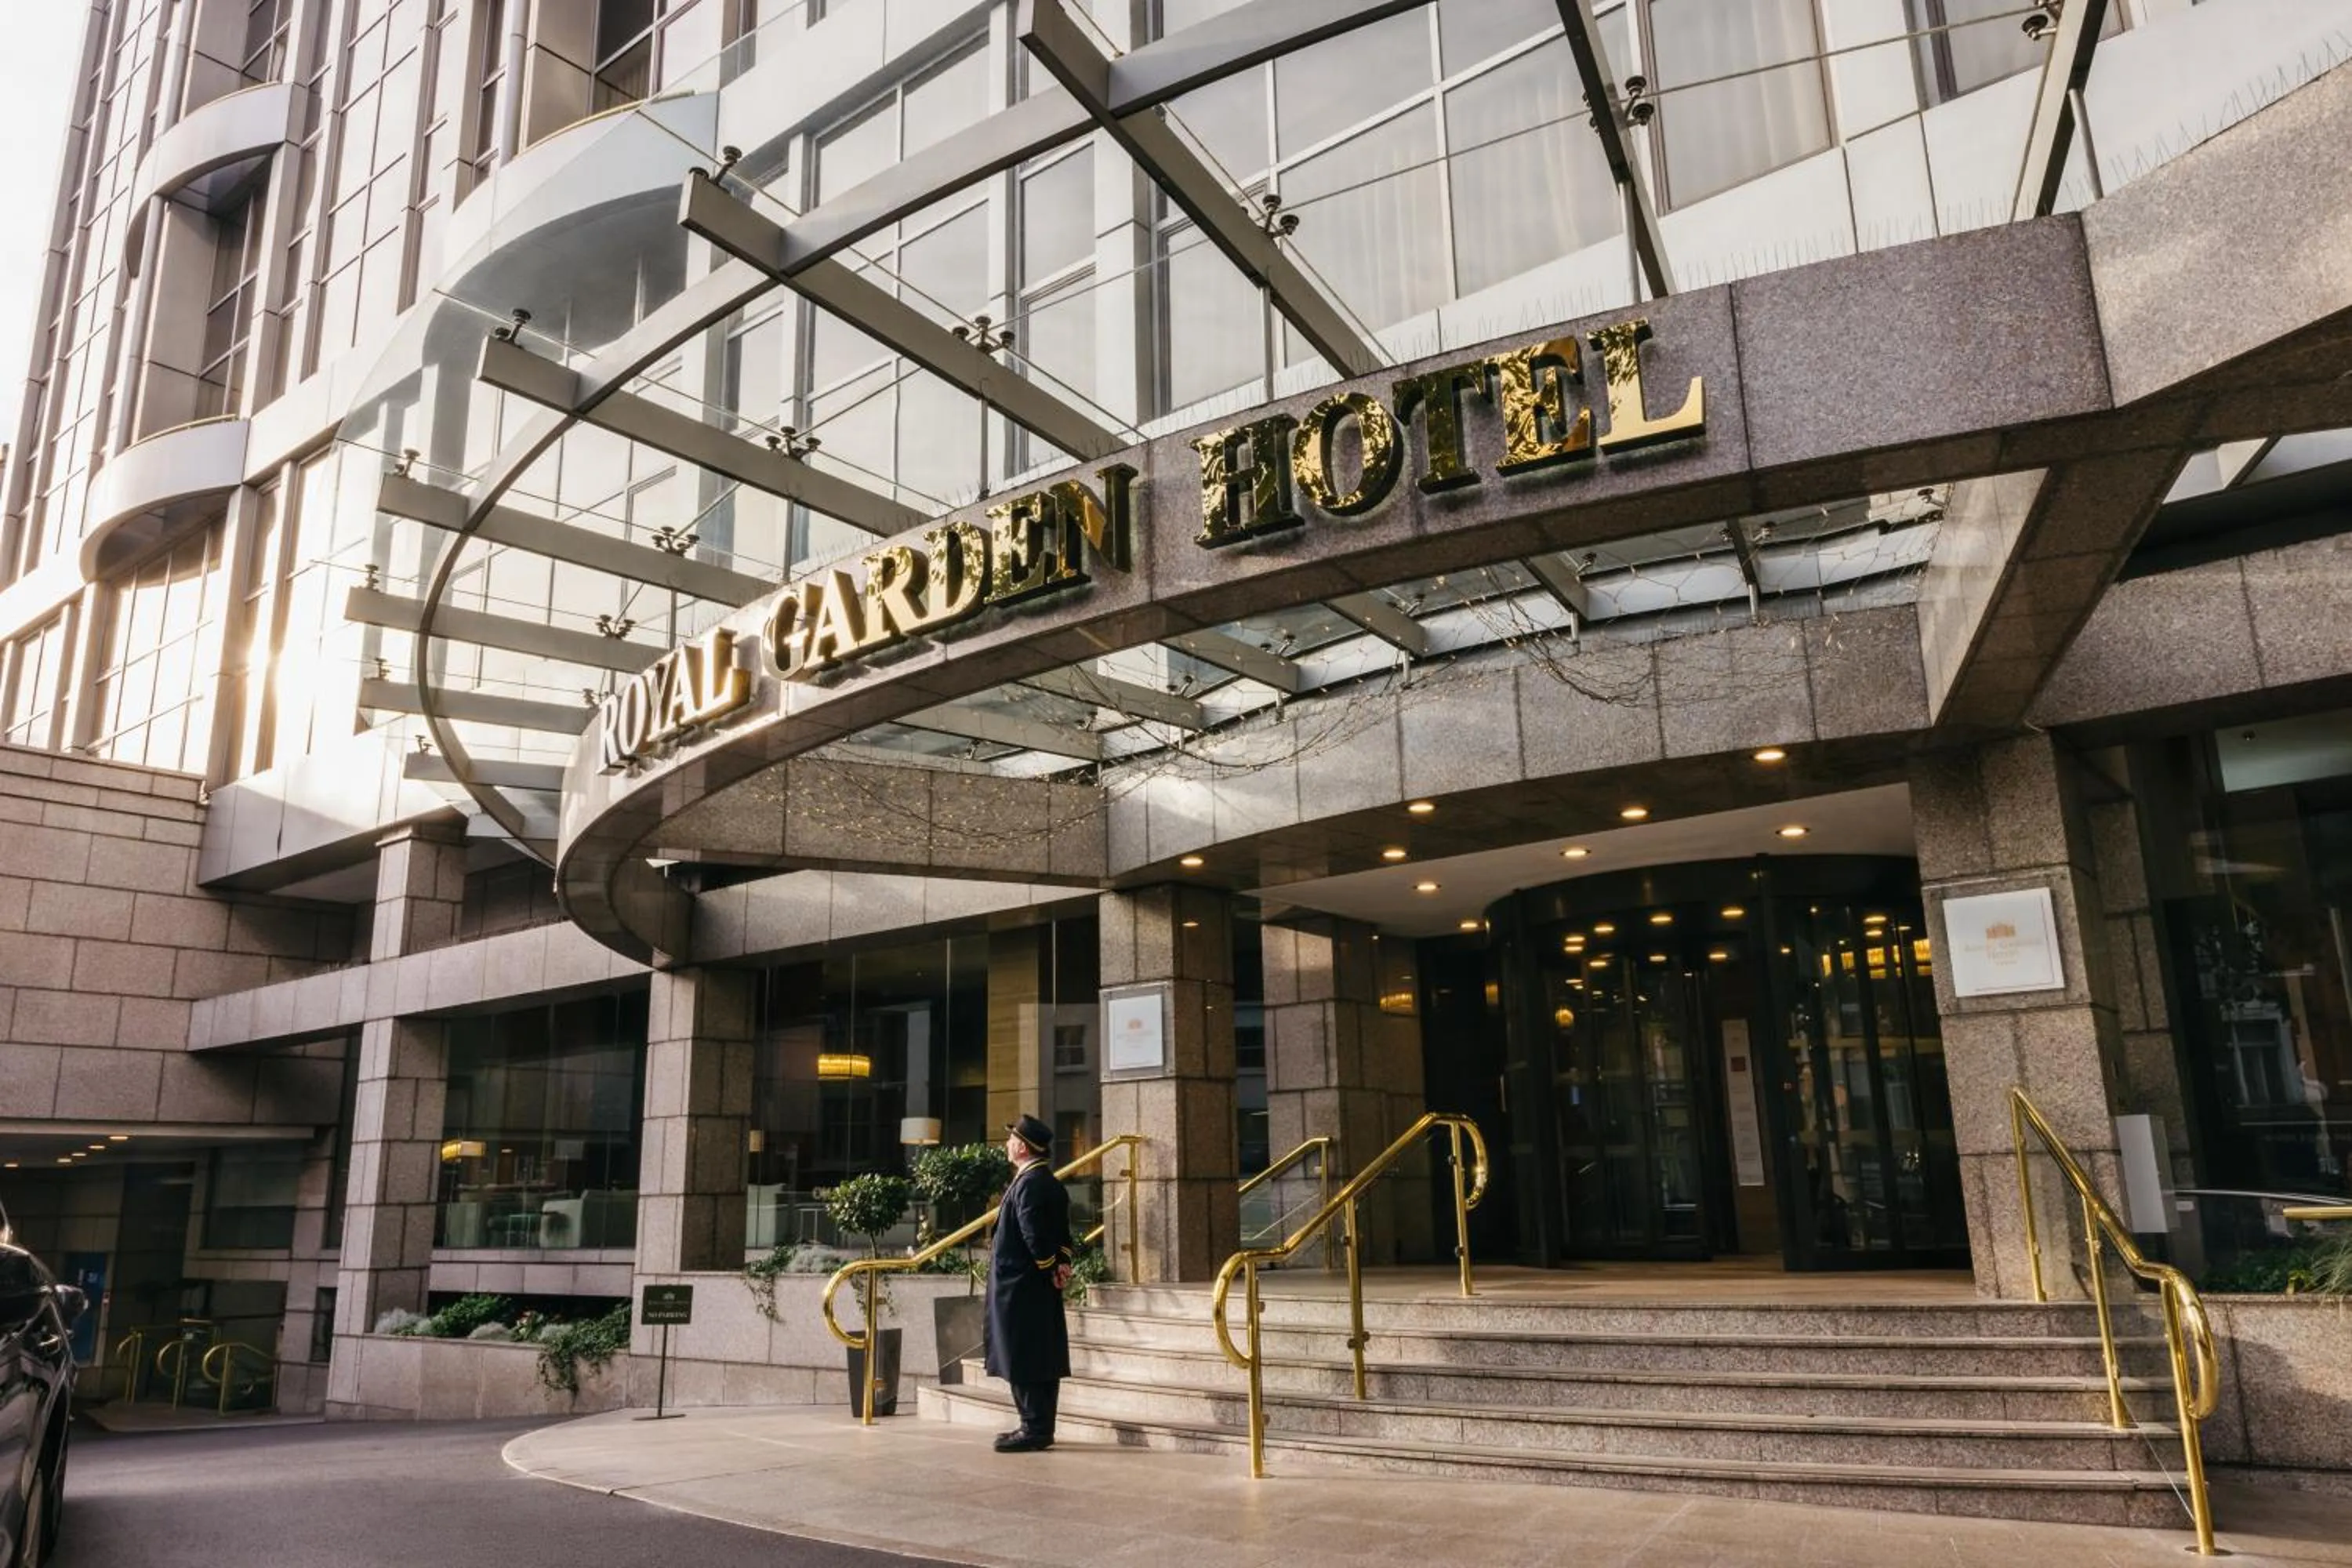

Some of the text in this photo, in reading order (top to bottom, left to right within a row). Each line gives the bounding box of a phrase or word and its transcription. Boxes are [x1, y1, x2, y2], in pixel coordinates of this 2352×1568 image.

[597, 319, 1705, 775] ROYAL GARDEN HOTEL
